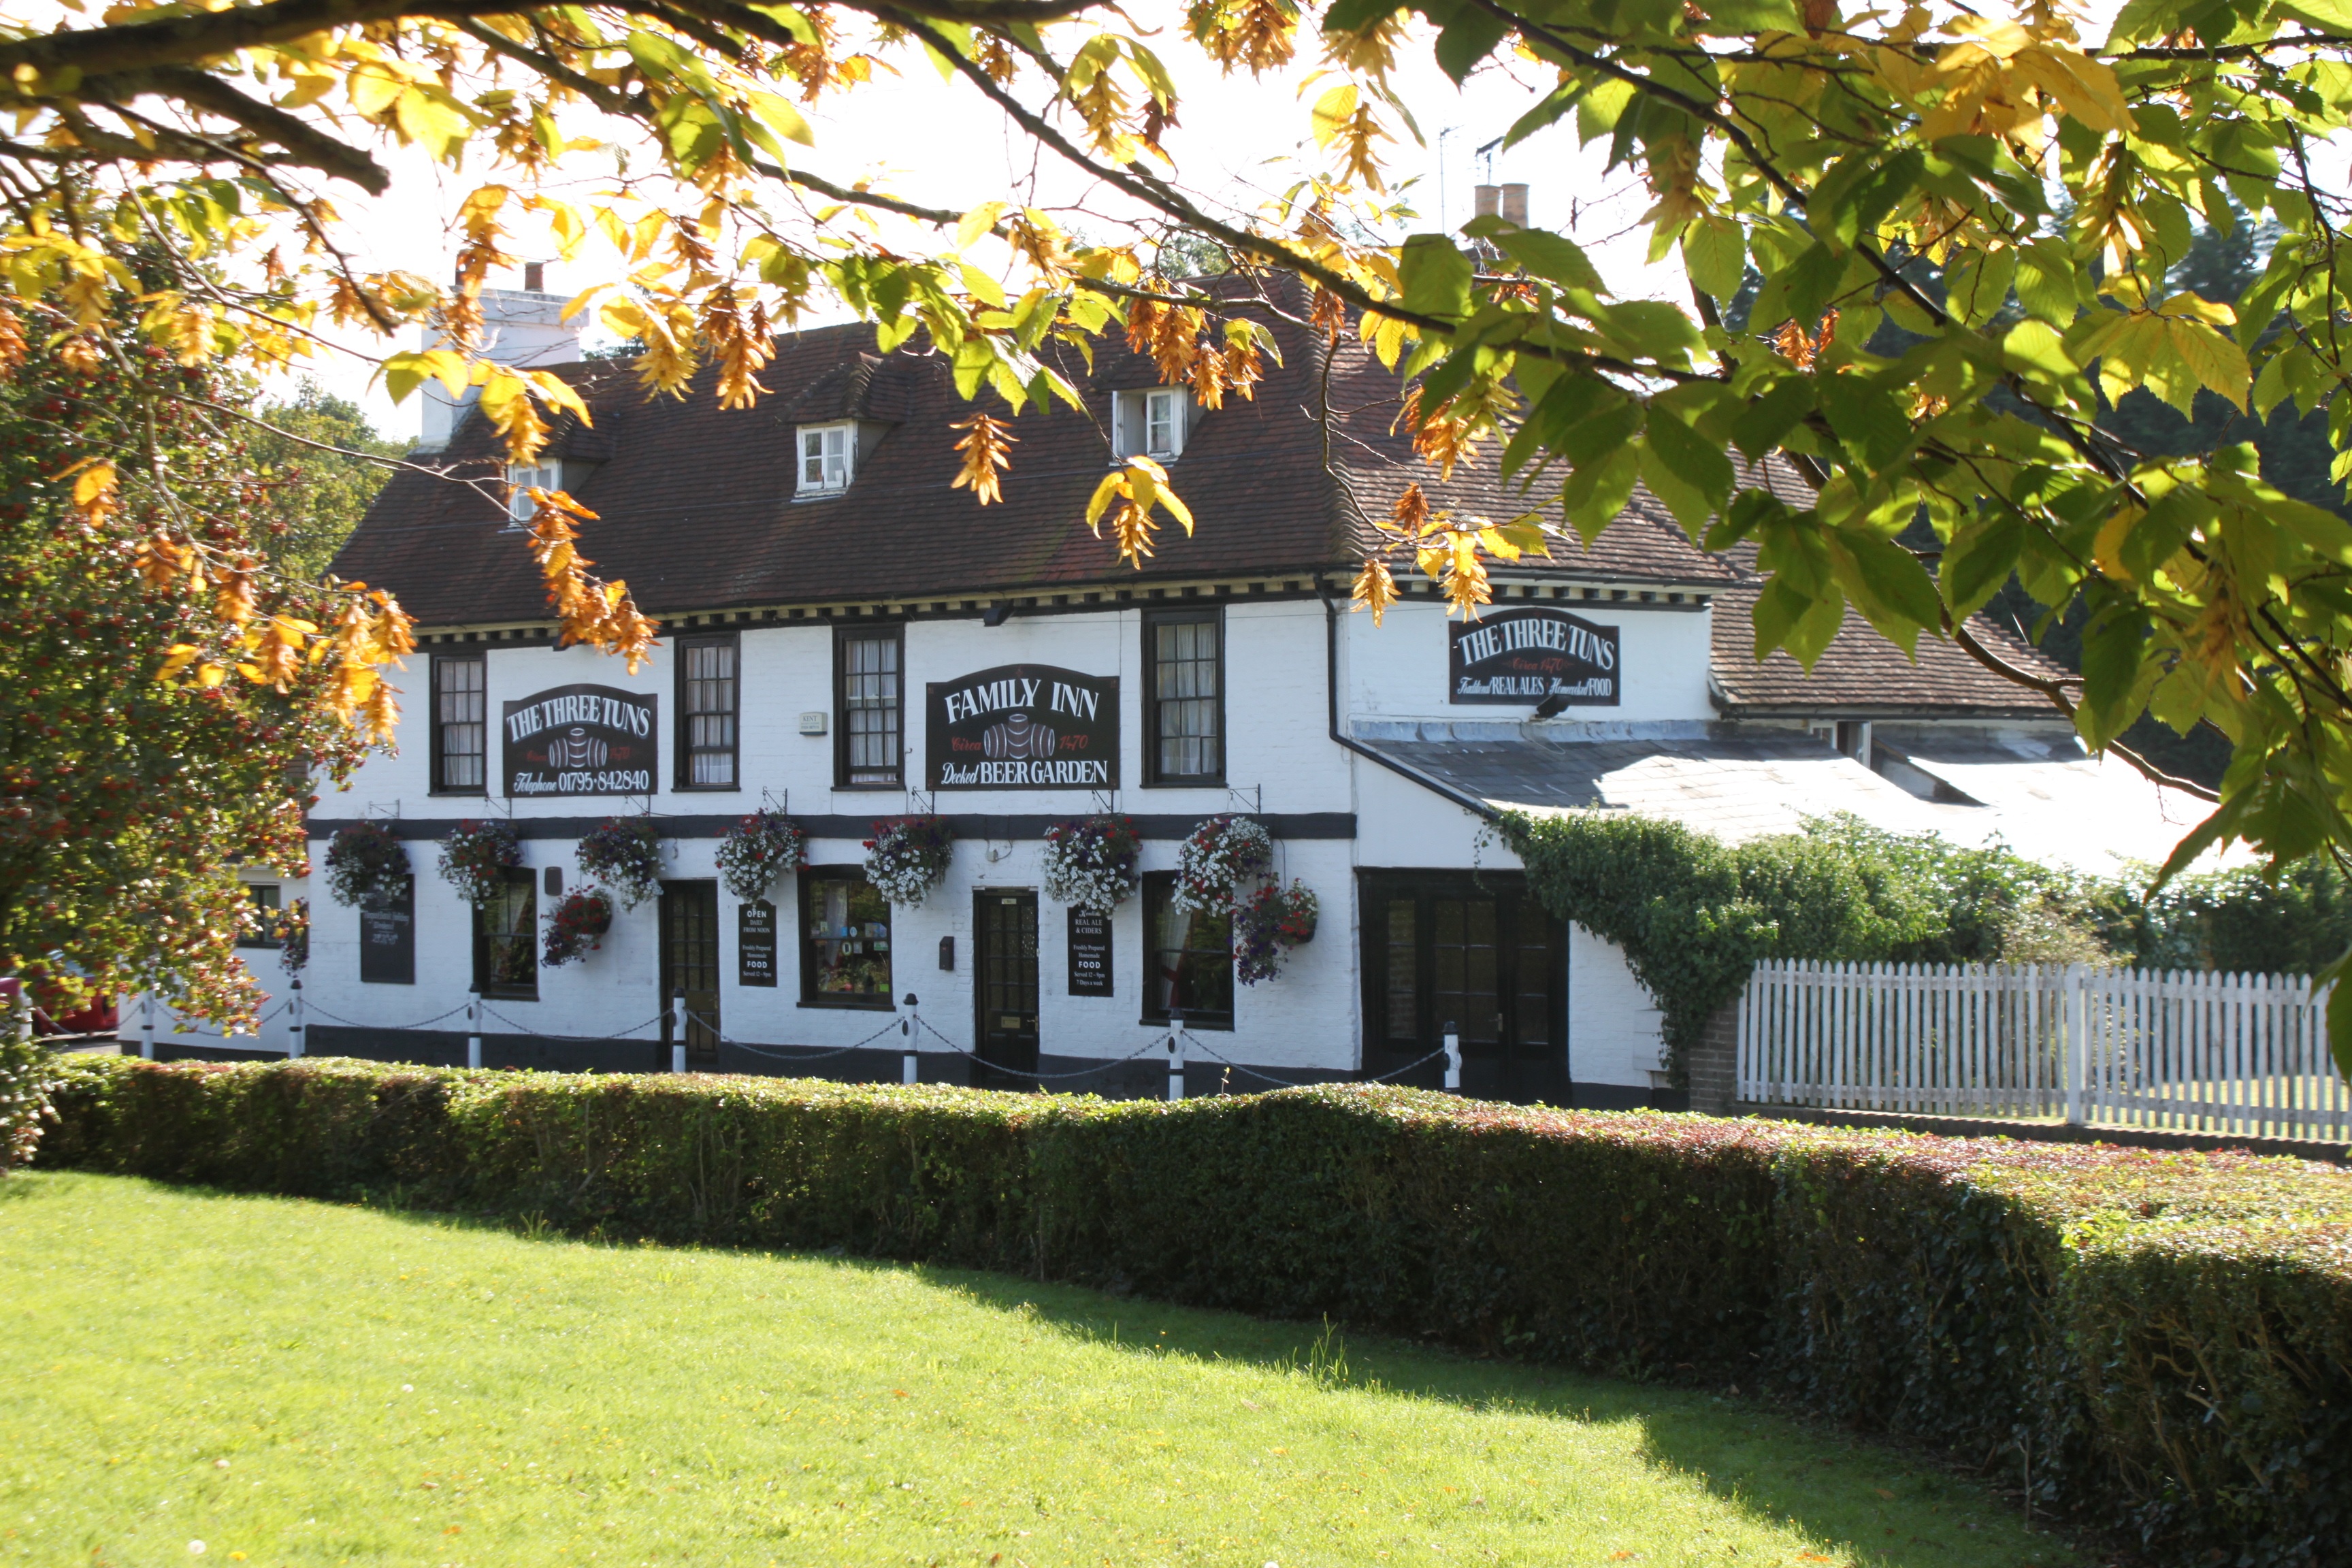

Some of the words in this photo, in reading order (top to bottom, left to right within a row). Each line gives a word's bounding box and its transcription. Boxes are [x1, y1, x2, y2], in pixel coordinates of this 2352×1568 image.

[1458, 624, 1502, 666] THE
[1501, 619, 1567, 651] THREE
[1569, 625, 1614, 670] TUNS
[1540, 658, 1564, 674] 1470
[1492, 676, 1520, 695] REAL
[1520, 676, 1544, 695] ALES
[1588, 678, 1612, 696] FOOD
[945, 679, 1041, 724] FAMILY
[1050, 681, 1100, 722] INN
[506, 704, 542, 742] THE
[542, 695, 601, 728] THREE
[602, 698, 651, 738] TUNS
[951, 736, 982, 751] Circa
[1059, 734, 1089, 751] 1470
[514, 772, 557, 794] Telephone
[941, 762, 979, 785] Decked
[980, 762, 1030, 784] BEER
[1030, 760, 1108, 784] GARDEN
